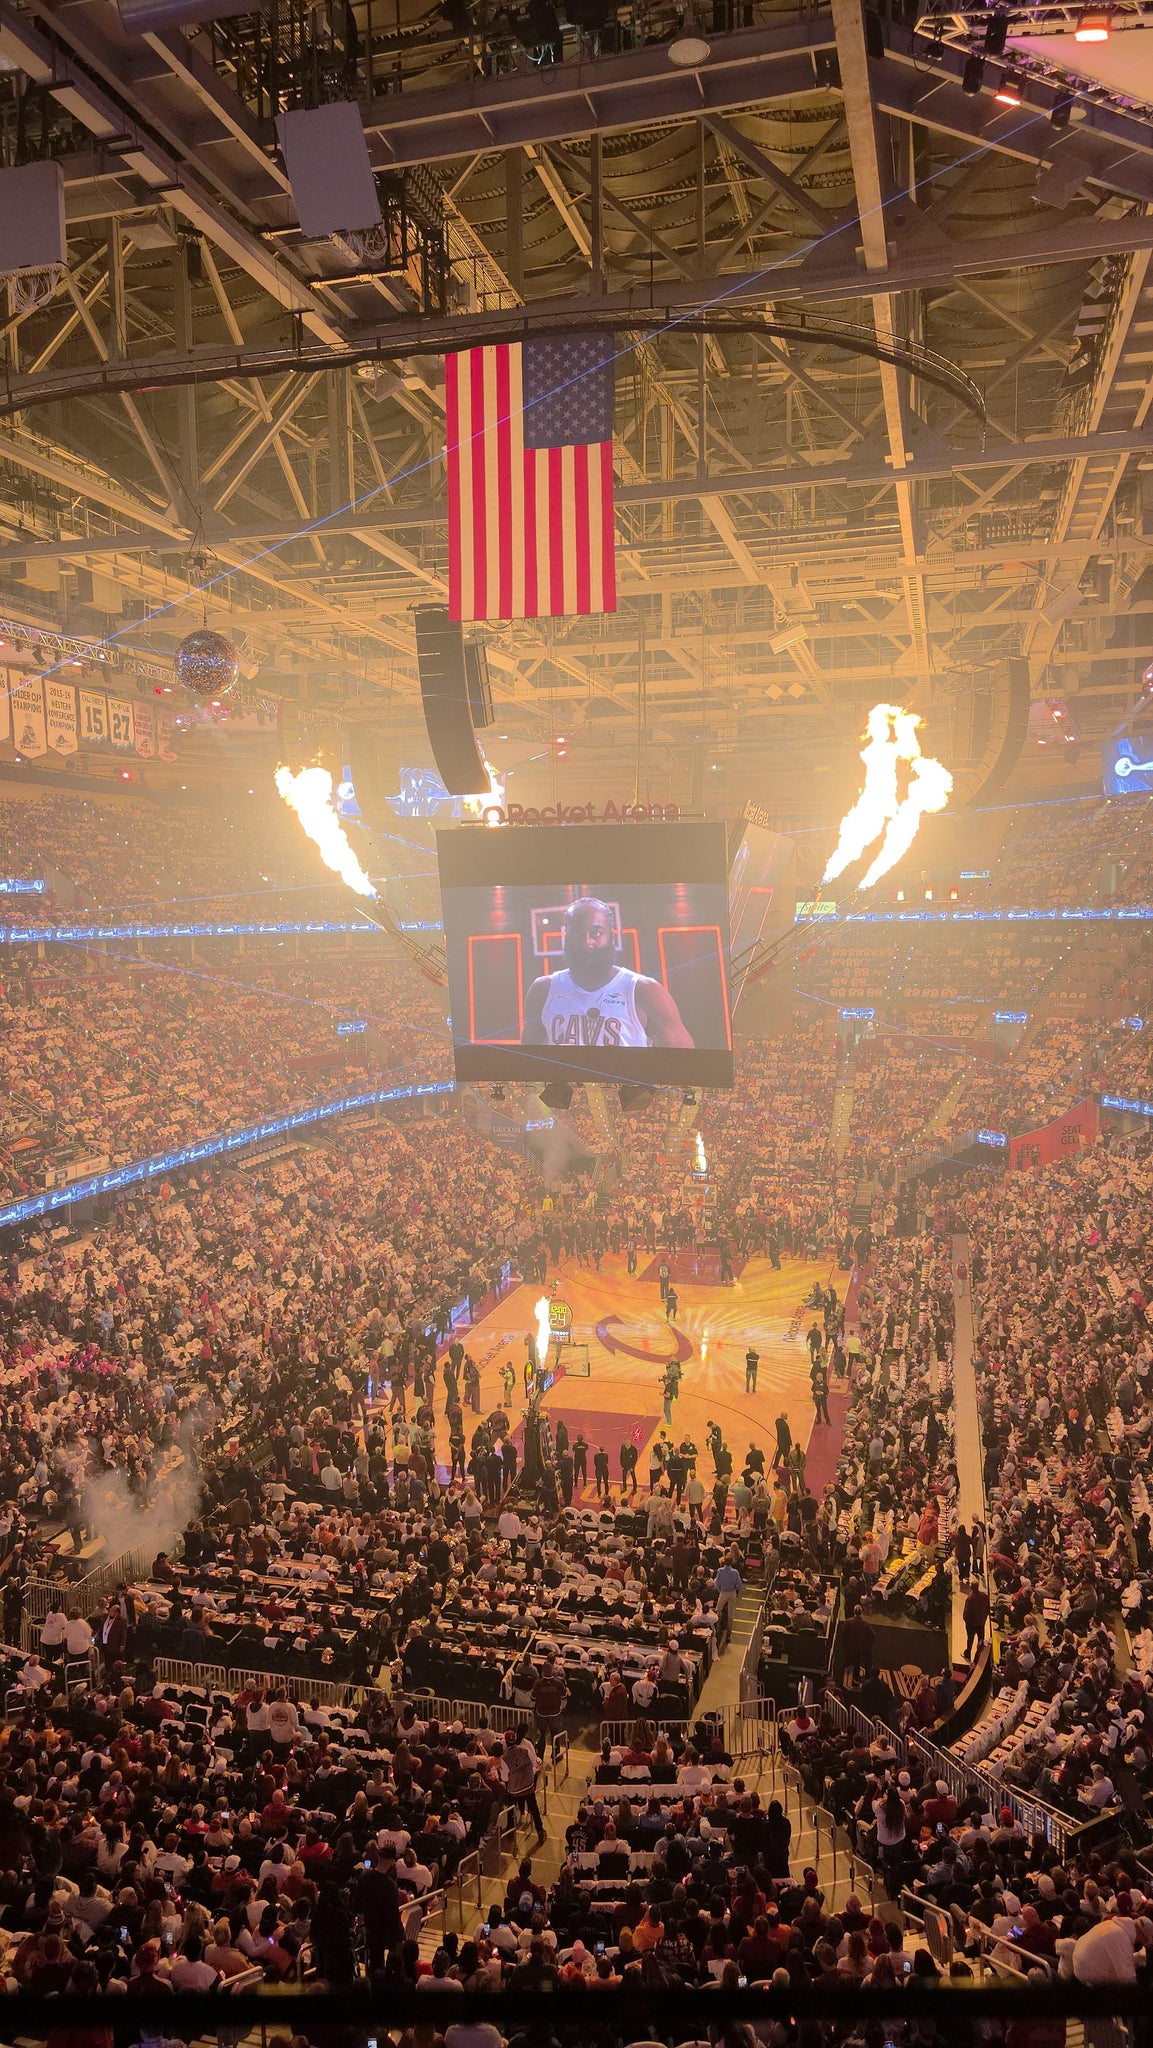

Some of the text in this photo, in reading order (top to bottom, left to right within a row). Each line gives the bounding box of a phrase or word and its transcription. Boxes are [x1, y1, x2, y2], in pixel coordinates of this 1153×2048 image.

[85, 706, 104, 735] 15
[112, 712, 130, 742] 27
[507, 799, 680, 825] Rocket Arena
[551, 1015, 622, 1047] CAVS
[1060, 1134, 1080, 1145] GEE
[1062, 1125, 1082, 1135] SEAT
